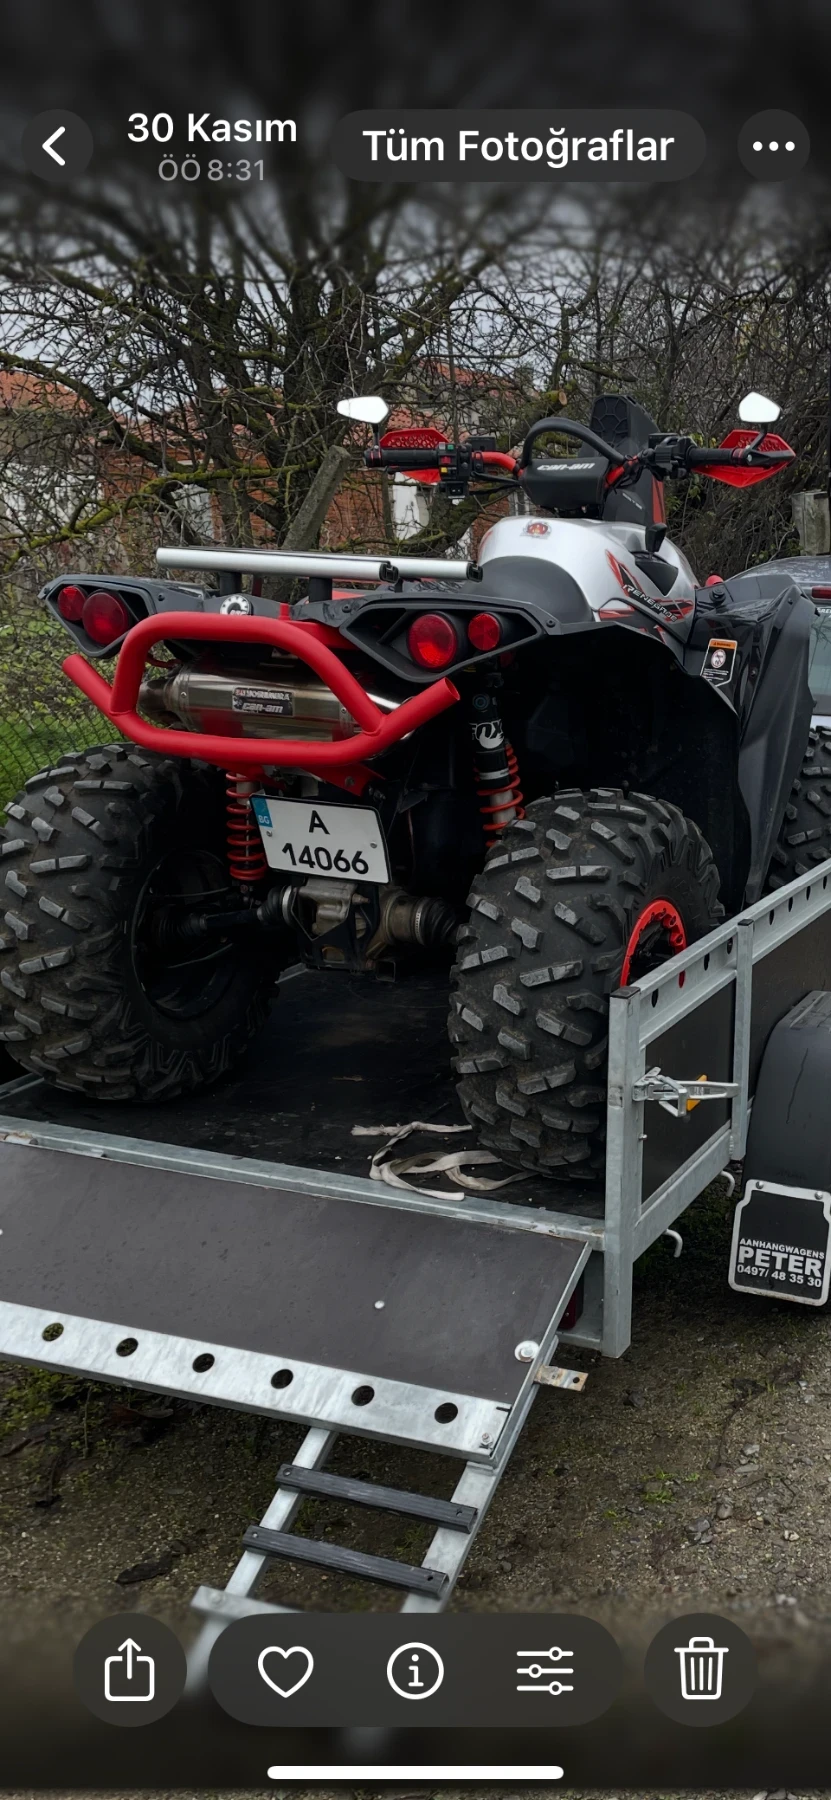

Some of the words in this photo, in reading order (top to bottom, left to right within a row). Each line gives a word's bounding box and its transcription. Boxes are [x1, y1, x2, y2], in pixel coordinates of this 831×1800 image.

[622, 584, 678, 622] RENEGADE
[242, 702, 283, 713] can-am
[258, 816, 270, 825] BG
[309, 810, 330, 835] A
[281, 843, 369, 875] 14066
[739, 1238, 825, 1260] AANHANGWAGENS
[738, 1246, 822, 1277] PETER
[737, 1264, 769, 1278] 0497/
[771, 1271, 786, 1281] 48
[789, 1274, 804, 1284] 35
[807, 1277, 822, 1288] 30
